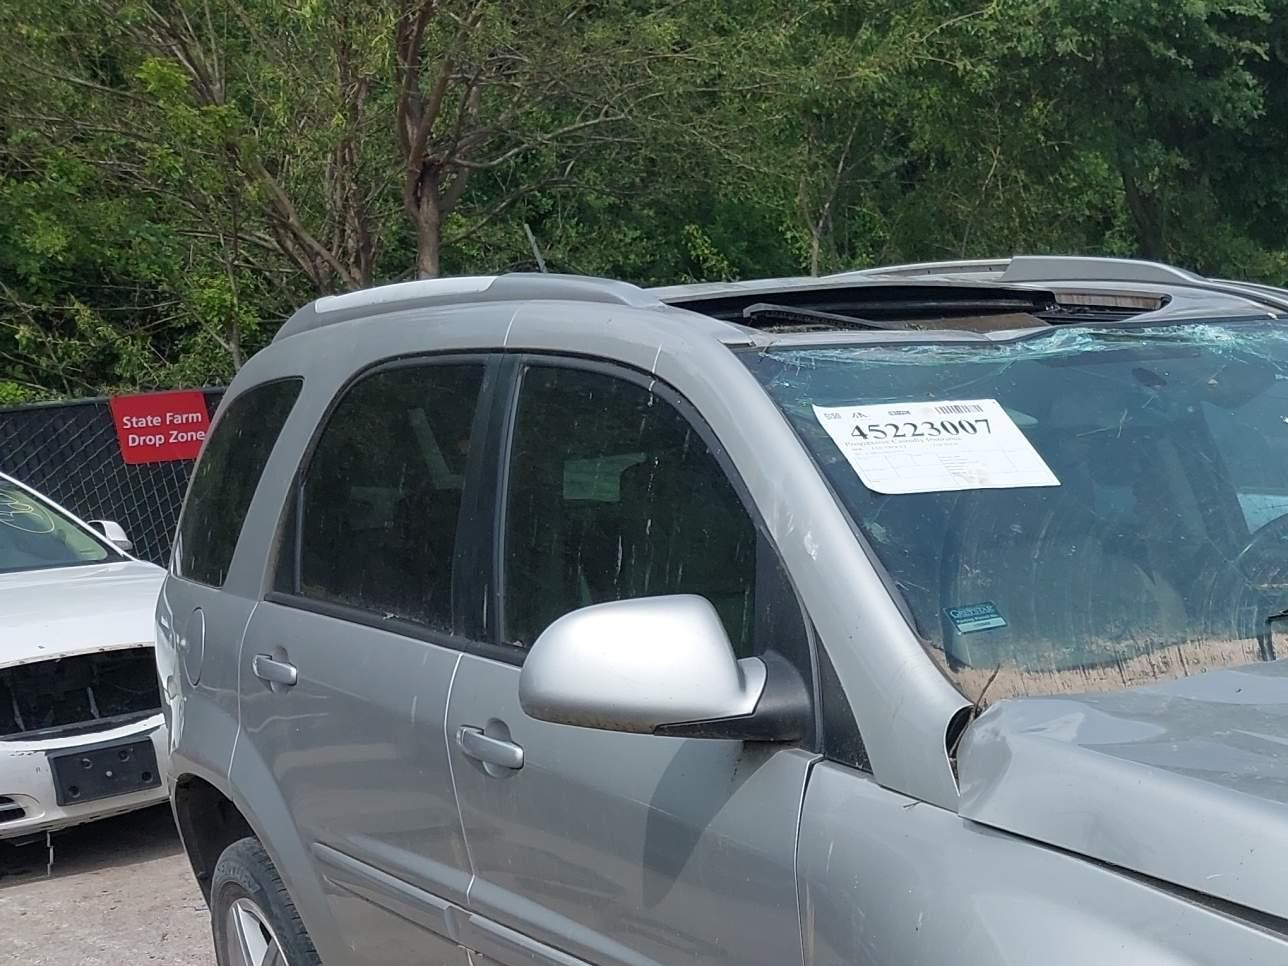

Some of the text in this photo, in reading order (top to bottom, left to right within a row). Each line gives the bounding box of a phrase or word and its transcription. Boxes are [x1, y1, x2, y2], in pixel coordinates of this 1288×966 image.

[122, 412, 202, 429] State Farm
[850, 418, 992, 440] 45223007
[128, 430, 206, 448] Drop Zone
